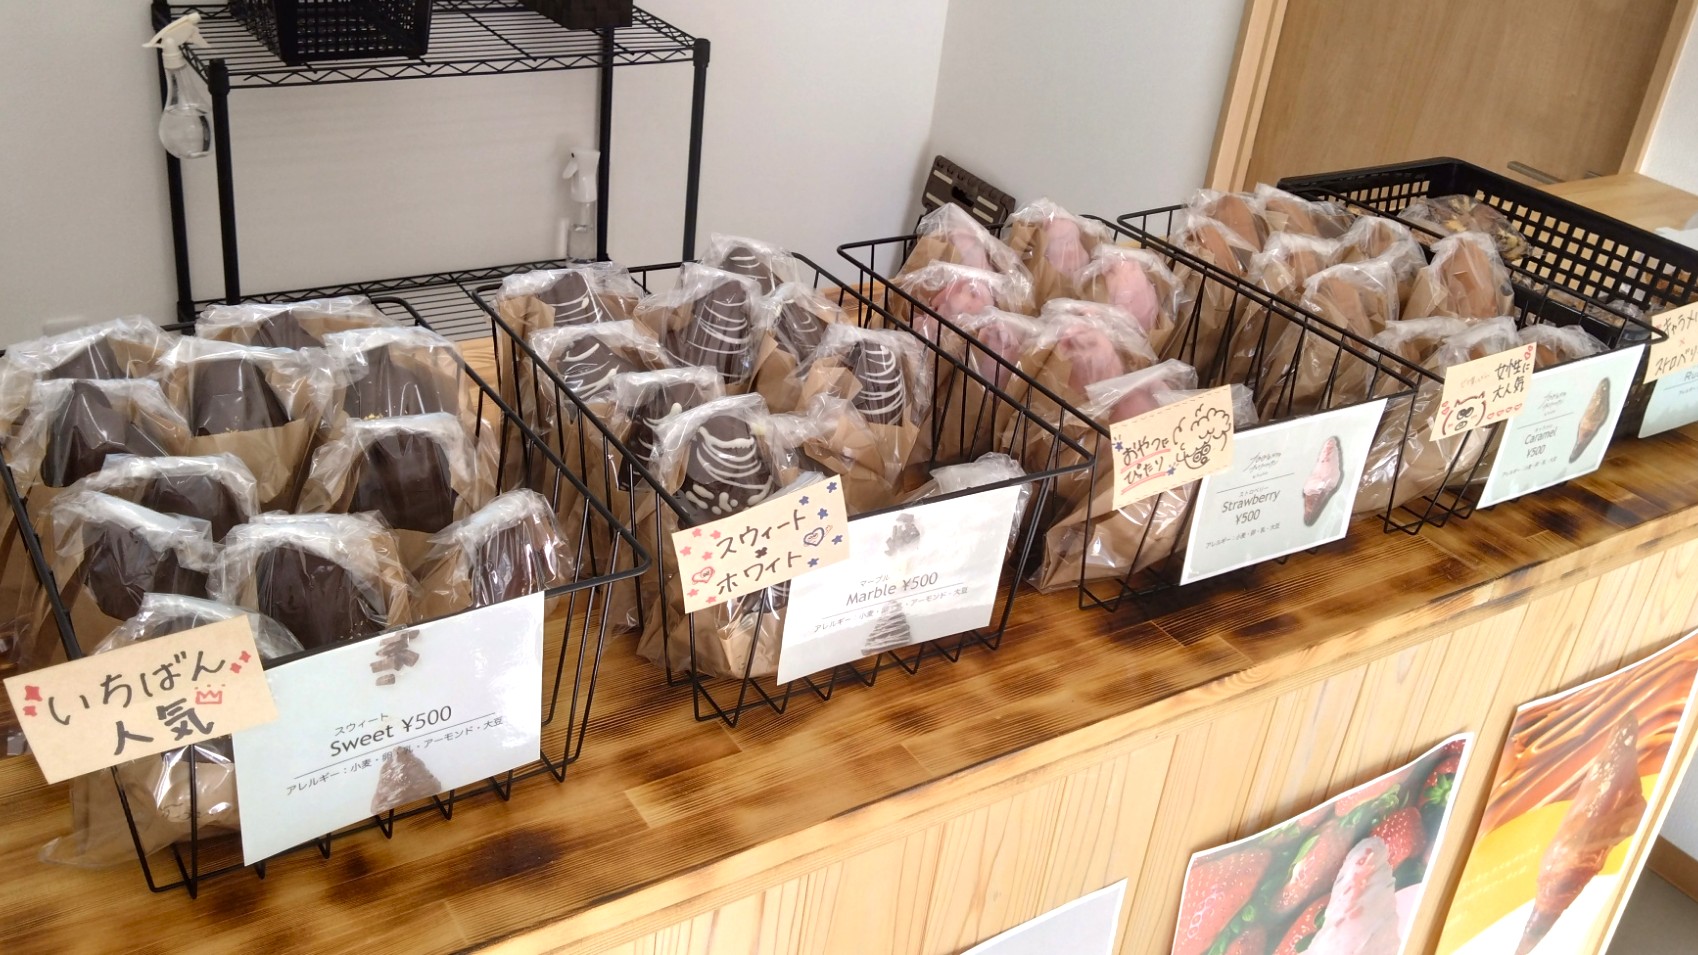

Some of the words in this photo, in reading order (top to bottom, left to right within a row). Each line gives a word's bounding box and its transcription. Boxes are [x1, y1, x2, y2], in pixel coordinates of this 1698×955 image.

[1492, 375, 1524, 402] 大人気
[1524, 426, 1558, 445] Caramel
[1526, 444, 1547, 458] ¥500
[1221, 490, 1281, 513] Strawberry
[1235, 509, 1261, 525] ¥500
[716, 509, 806, 559] スウィート
[716, 551, 802, 595] ホワイト
[860, 574, 889, 587] マーブル
[845, 584, 897, 606] Marble
[902, 571, 938, 592] ¥500
[48, 650, 226, 726] いちばん
[114, 697, 215, 756] 人気
[330, 724, 394, 757] Sweet
[401, 705, 452, 733] ¥500
[334, 712, 389, 737] スウィート
